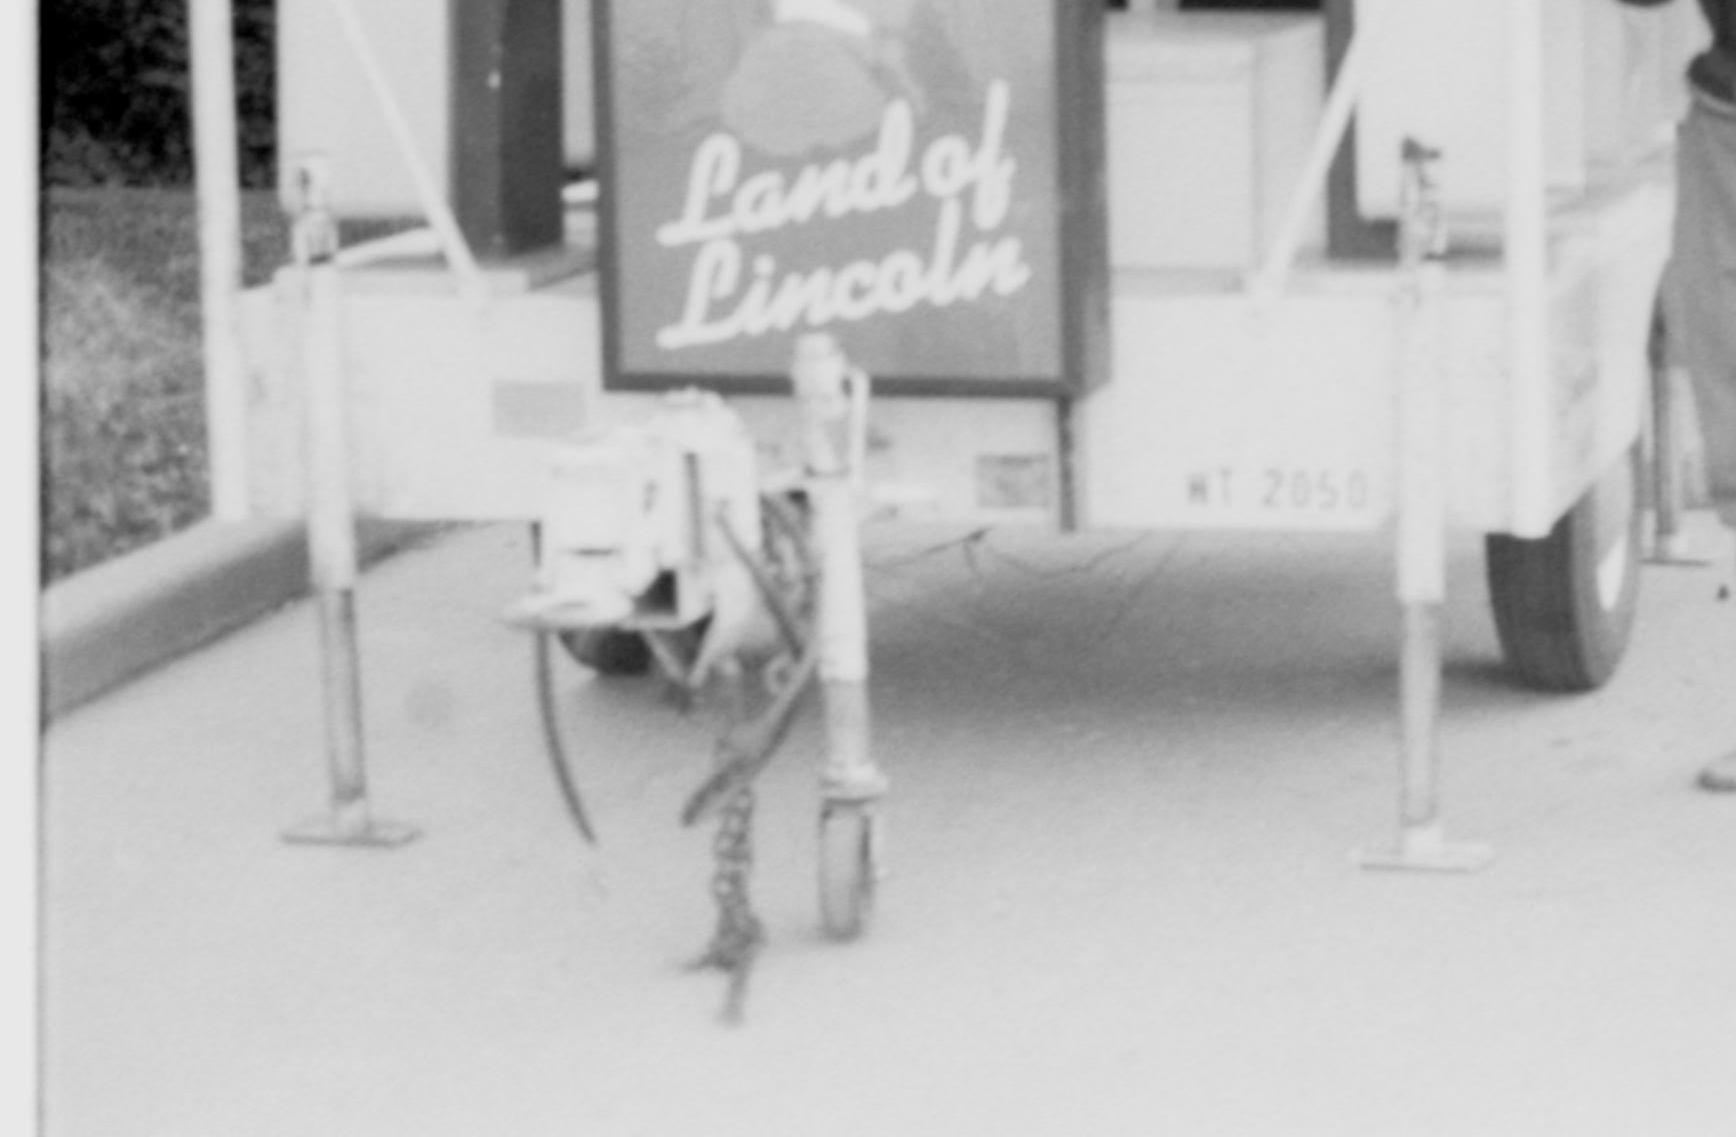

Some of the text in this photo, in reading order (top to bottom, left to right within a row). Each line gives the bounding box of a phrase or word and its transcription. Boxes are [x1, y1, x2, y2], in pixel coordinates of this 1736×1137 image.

[655, 78, 1016, 246] Land of
[655, 197, 1031, 350] Lincoln
